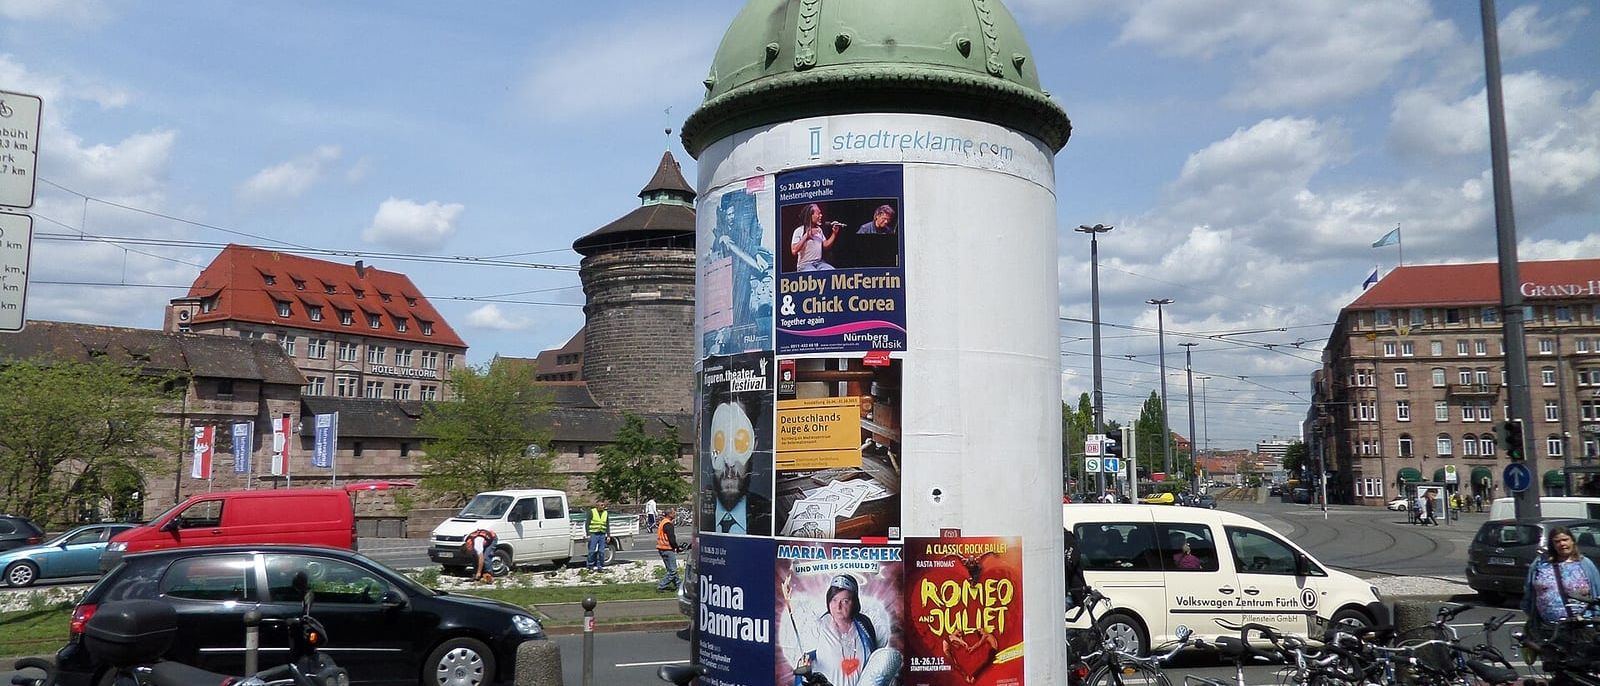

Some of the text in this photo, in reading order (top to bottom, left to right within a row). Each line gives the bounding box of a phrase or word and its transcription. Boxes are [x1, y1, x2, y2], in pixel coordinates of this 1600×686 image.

[0, 128, 28, 139] bühl
[14, 140, 28, 151] km
[832, 128, 1014, 162] stadtreklame.com
[0, 154, 14, 163] rk
[12, 166, 26, 176] km
[788, 181, 811, 191] 21.06.15
[812, 180, 821, 188] 20
[822, 178, 834, 186] Uhr
[780, 188, 834, 201] Meistersingerhalle
[7, 240, 22, 250] km
[4, 264, 20, 273] km
[3, 282, 19, 292] km
[780, 272, 900, 295] Bobby McFerrin
[1, 301, 17, 310] km
[780, 294, 895, 316] & Chick Corea
[781, 316, 825, 328] Together again
[843, 333, 889, 342] Nürnberg
[872, 340, 902, 349] Musik
[372, 365, 437, 378] HOTEL VICTORIA
[731, 377, 765, 391] festival
[781, 413, 841, 424] Deutschlands
[781, 423, 829, 435] Auge & Ohr
[1087, 459, 1098, 471] S
[777, 545, 902, 561] MARIA PESCHEK
[926, 543, 1007, 554] A CLASSIC ROCK BALLET
[700, 575, 744, 610] Diana
[921, 578, 1014, 608] ROMEO
[1176, 596, 1233, 608] Volkswagen
[1235, 597, 1274, 607] Zentrum
[1276, 598, 1299, 608] Fürth
[700, 602, 769, 643] Damrau
[928, 606, 1008, 637] JULIET
[1242, 615, 1275, 623] Pillenstein
[911, 657, 945, 665] 18.-26.7.15
